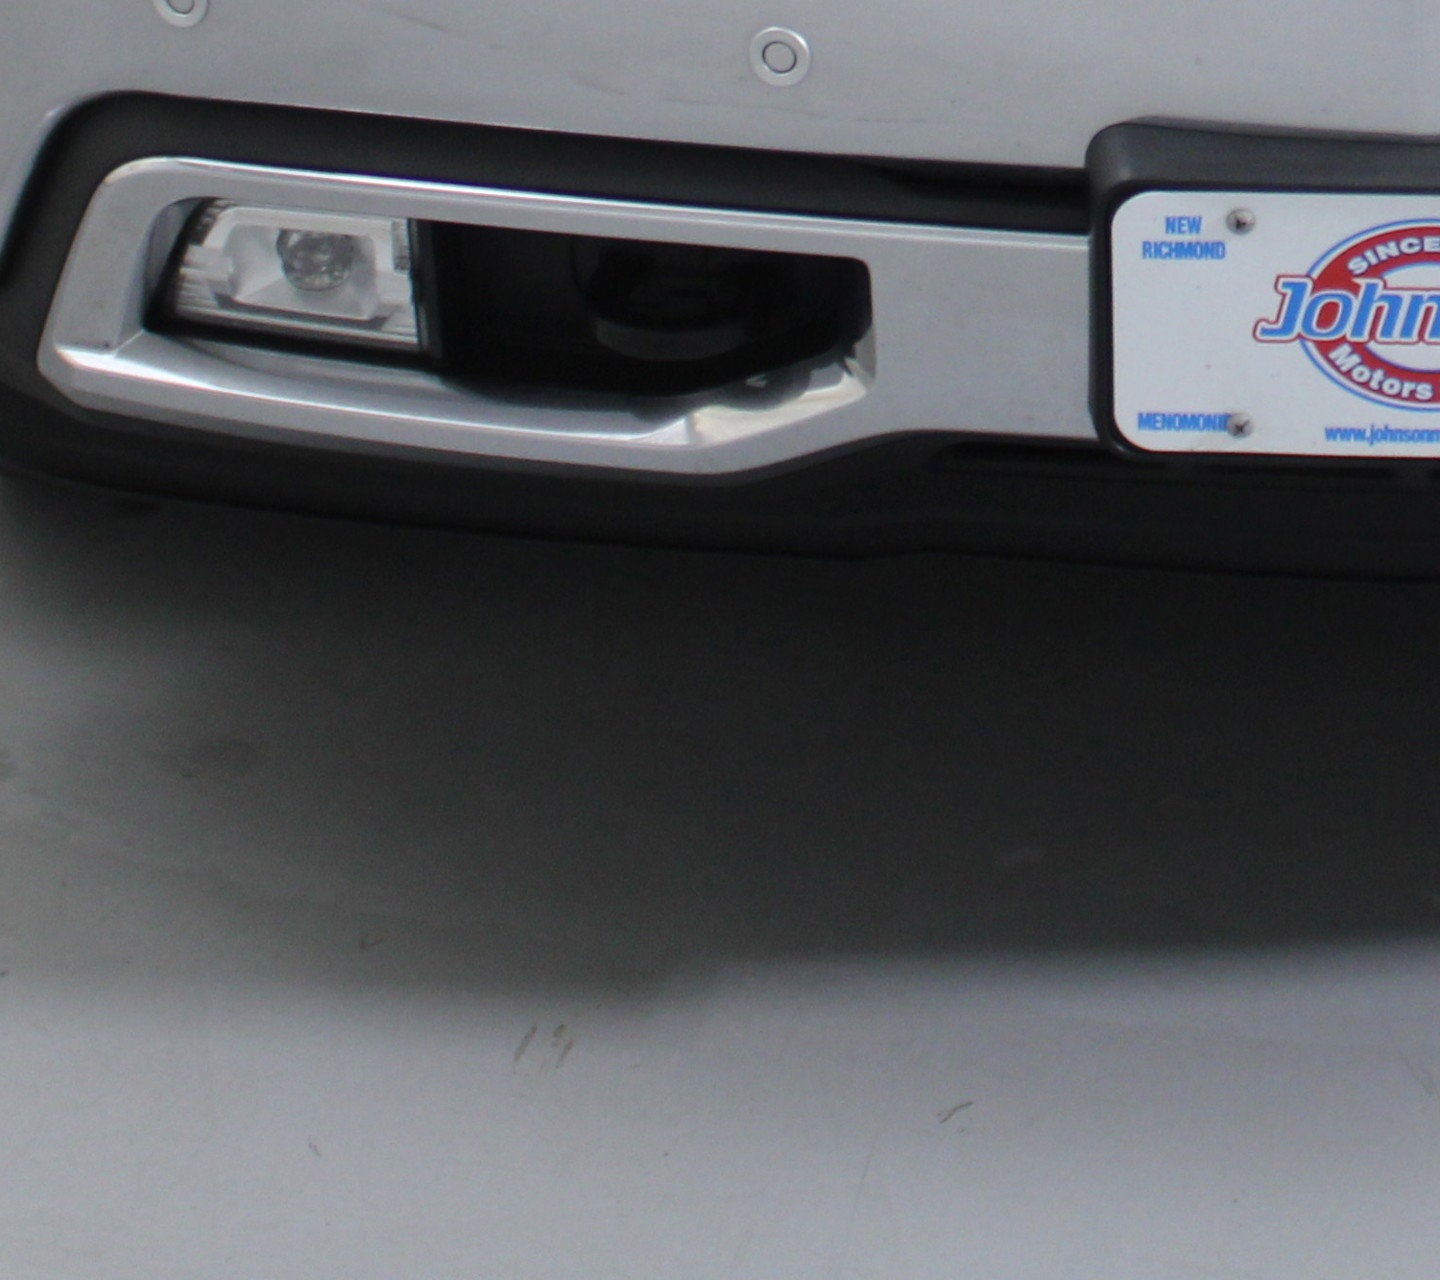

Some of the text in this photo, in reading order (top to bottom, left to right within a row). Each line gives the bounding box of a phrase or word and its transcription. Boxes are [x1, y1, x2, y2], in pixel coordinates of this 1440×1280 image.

[1164, 215, 1203, 235] NEW
[1142, 241, 1226, 260] RICHMOND
[1327, 343, 1433, 402] Motors
